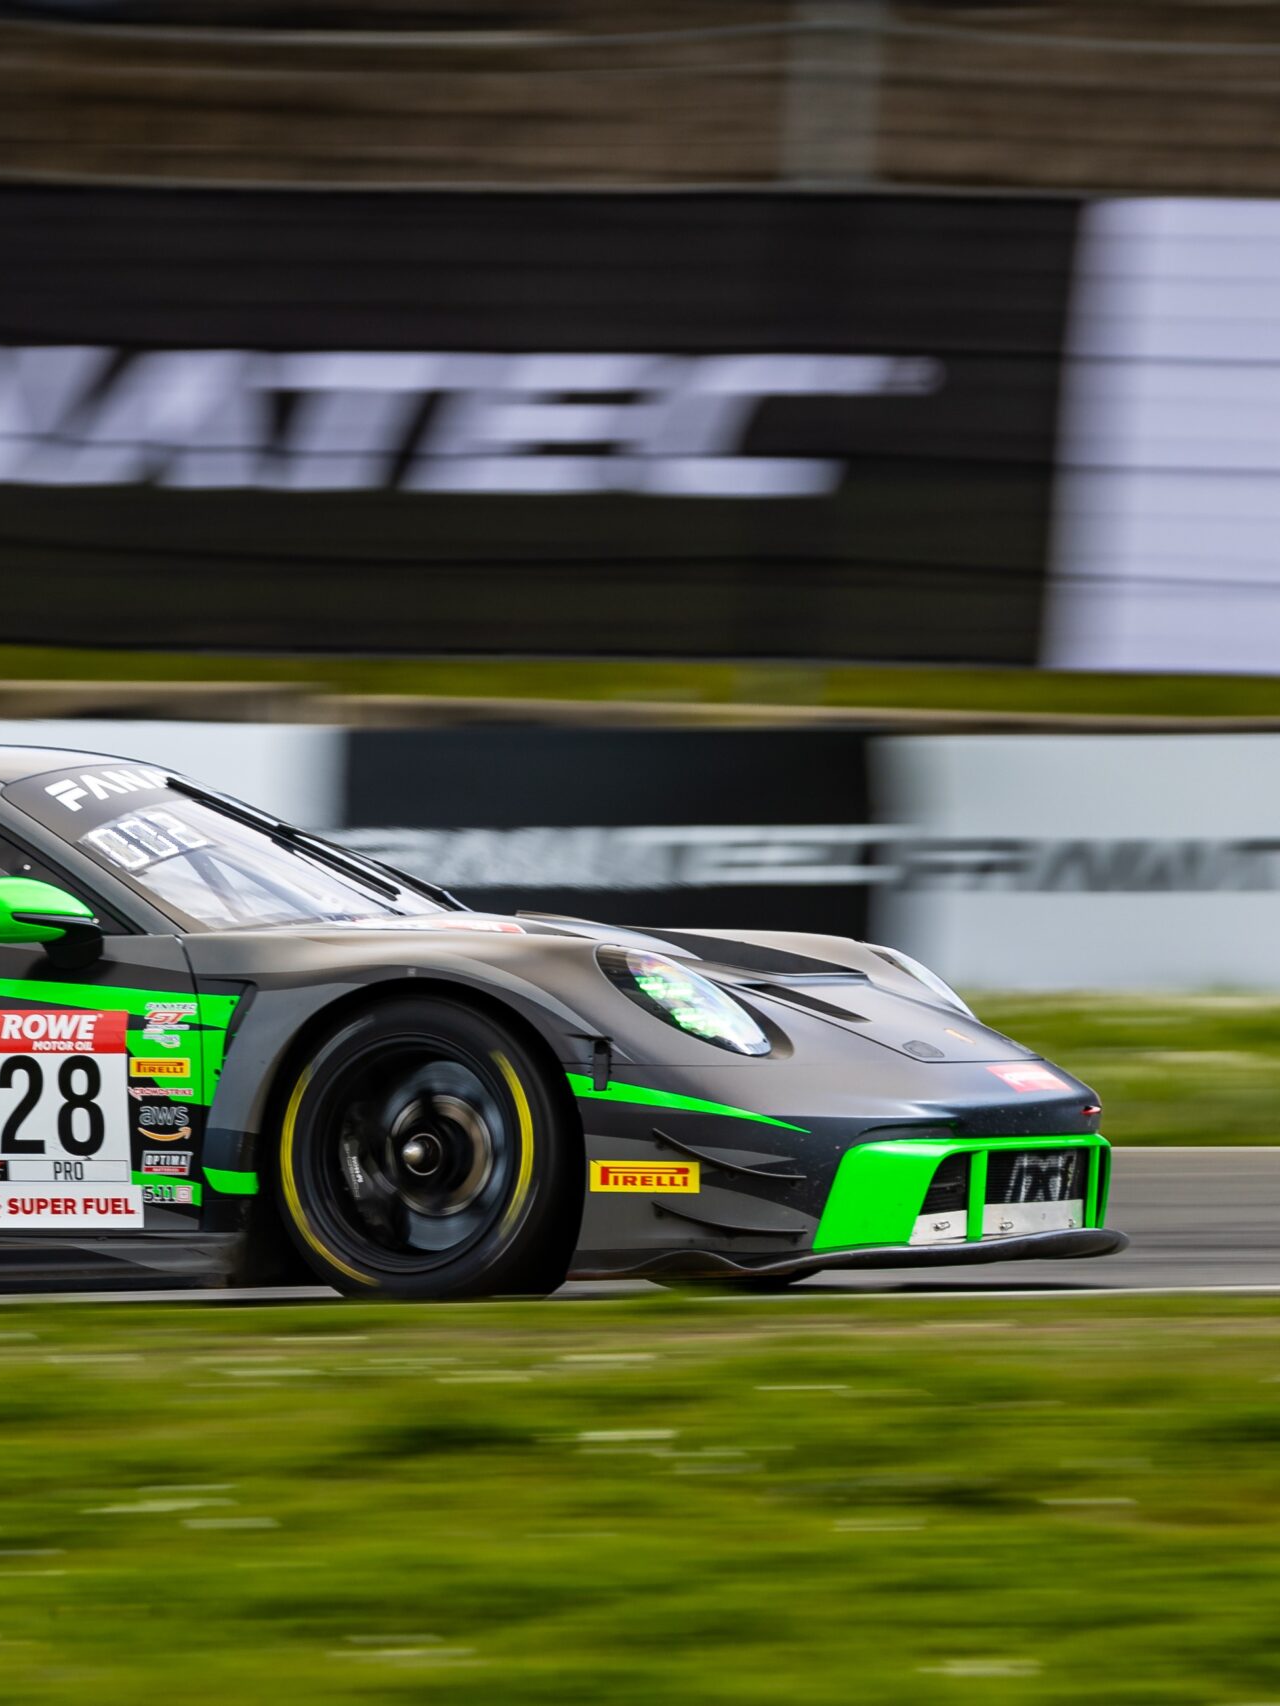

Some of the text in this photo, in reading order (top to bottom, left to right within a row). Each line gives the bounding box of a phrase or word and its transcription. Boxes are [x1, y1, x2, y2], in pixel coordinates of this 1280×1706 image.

[1, 1014, 97, 1039] ROWE
[32, 1041, 95, 1051] MOTOR OIL
[136, 1061, 184, 1073] PIRELLI
[140, 1106, 190, 1126] aws
[145, 1154, 188, 1166] OPTIMA
[53, 1161, 84, 1180] PRO
[600, 1166, 689, 1187] PIRELLI
[8, 1198, 136, 1215] SUPER FUEL
